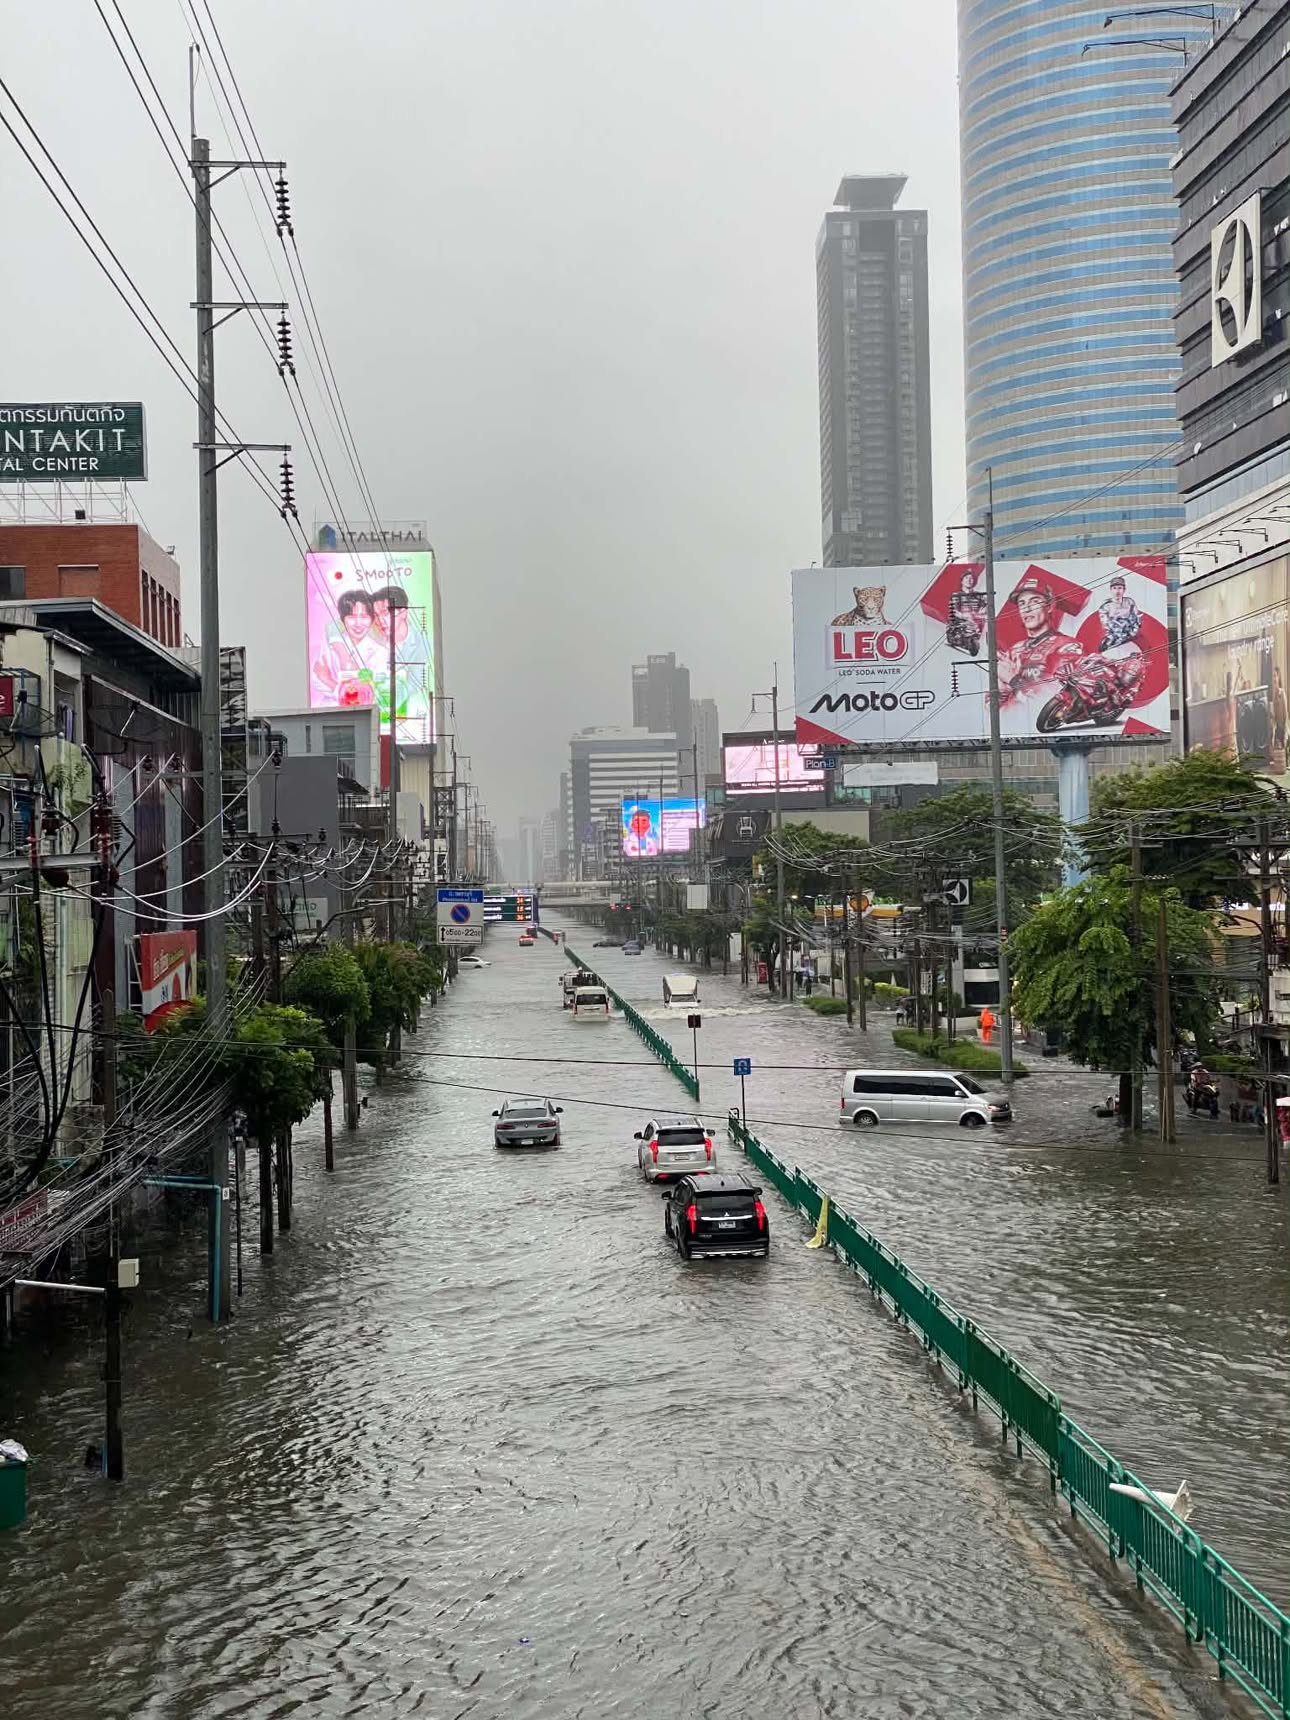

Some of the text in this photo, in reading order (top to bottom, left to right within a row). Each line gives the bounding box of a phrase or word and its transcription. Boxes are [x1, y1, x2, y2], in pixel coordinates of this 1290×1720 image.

[4, 429, 126, 452] NTAKIT
[32, 457, 99, 471] CENTER
[833, 629, 908, 662] LEO
